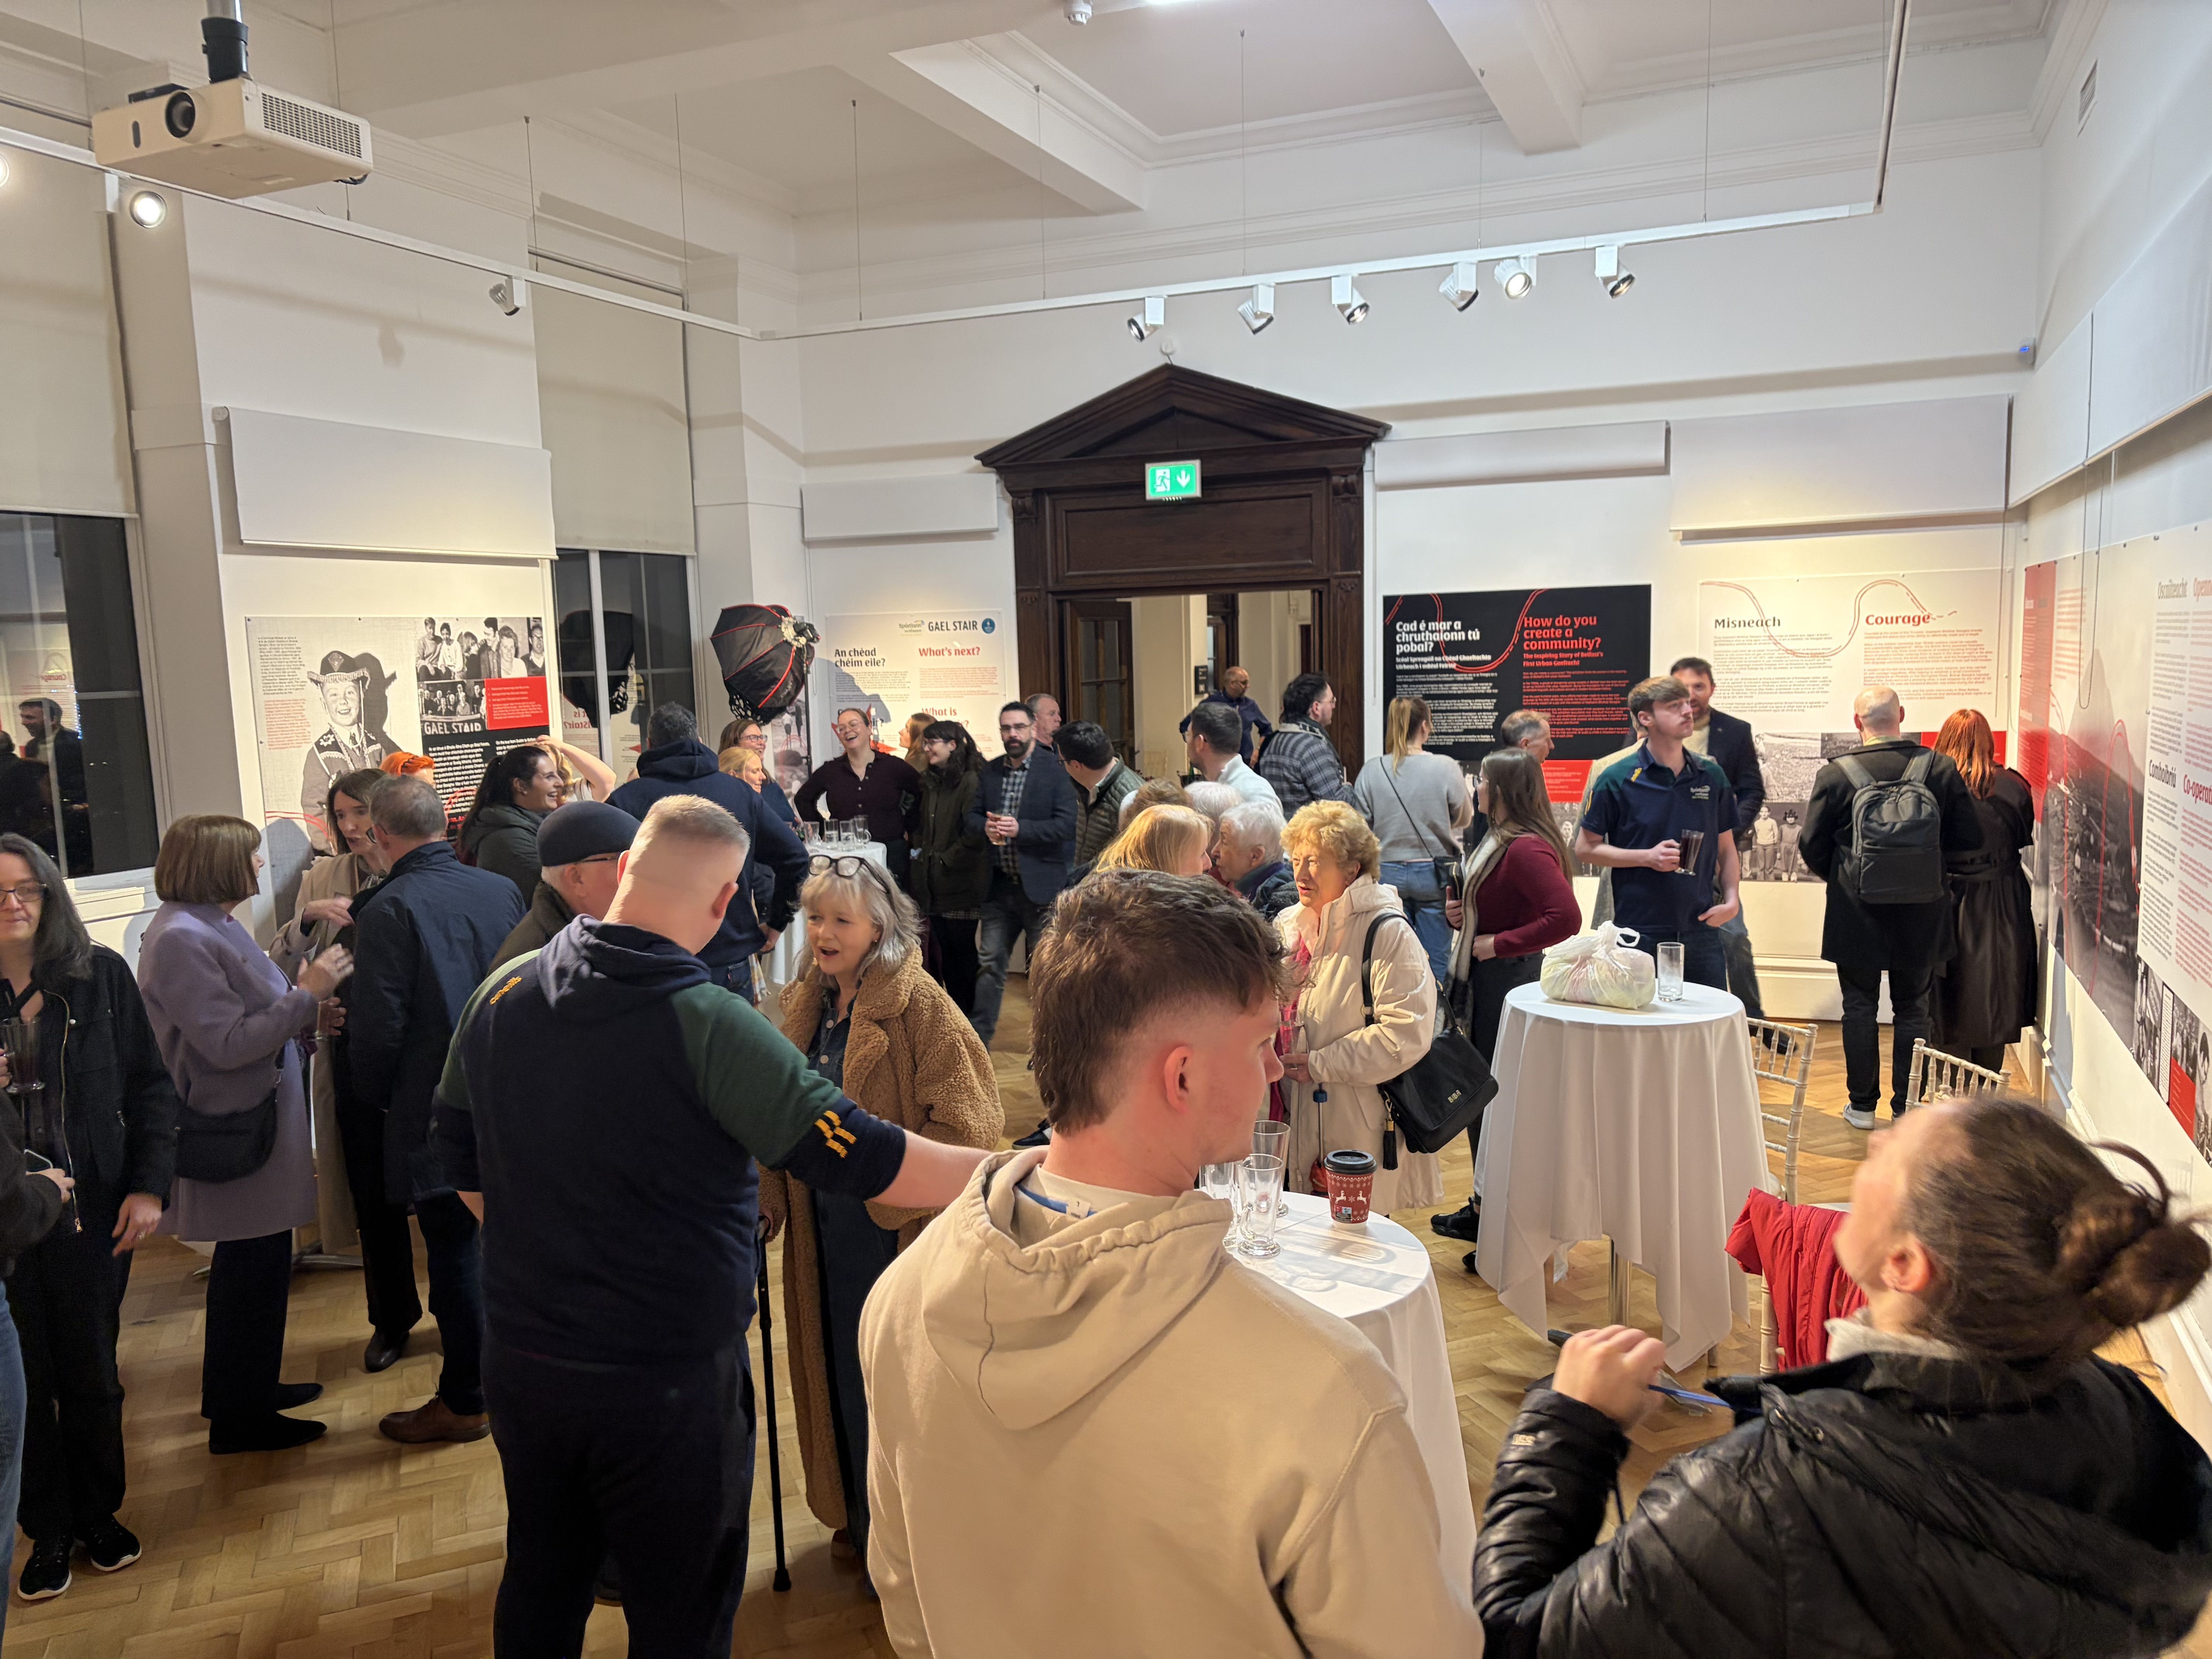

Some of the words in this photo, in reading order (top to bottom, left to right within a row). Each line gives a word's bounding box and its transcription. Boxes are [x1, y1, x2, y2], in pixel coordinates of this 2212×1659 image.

[928, 621, 950, 632] GAEL
[953, 620, 978, 630] STAIR
[1396, 620, 1417, 632] Cad
[1419, 620, 1426, 631] é
[1428, 621, 1452, 630] mar
[1453, 620, 1461, 630] a
[1523, 617, 1553, 628] How
[1555, 615, 1571, 627] do
[1574, 616, 1597, 629] you
[1714, 617, 1781, 629] Misneach
[1865, 614, 1930, 626] Courage
[1468, 628, 1480, 641] tú
[1523, 628, 1562, 639] create
[1565, 628, 1573, 638] a
[1396, 641, 1434, 655] pobal?
[1523, 637, 1601, 651] community?
[835, 649, 847, 657] An
[848, 647, 876, 657] chéad
[919, 647, 952, 656] What's
[954, 646, 981, 656] next?
[835, 658, 863, 667] chéim
[865, 658, 886, 667] eile?
[922, 707, 947, 716] What
[950, 707, 957, 716] is
[424, 721, 450, 735] GAEL
[1447, 1089, 1462, 1103] BIBA
